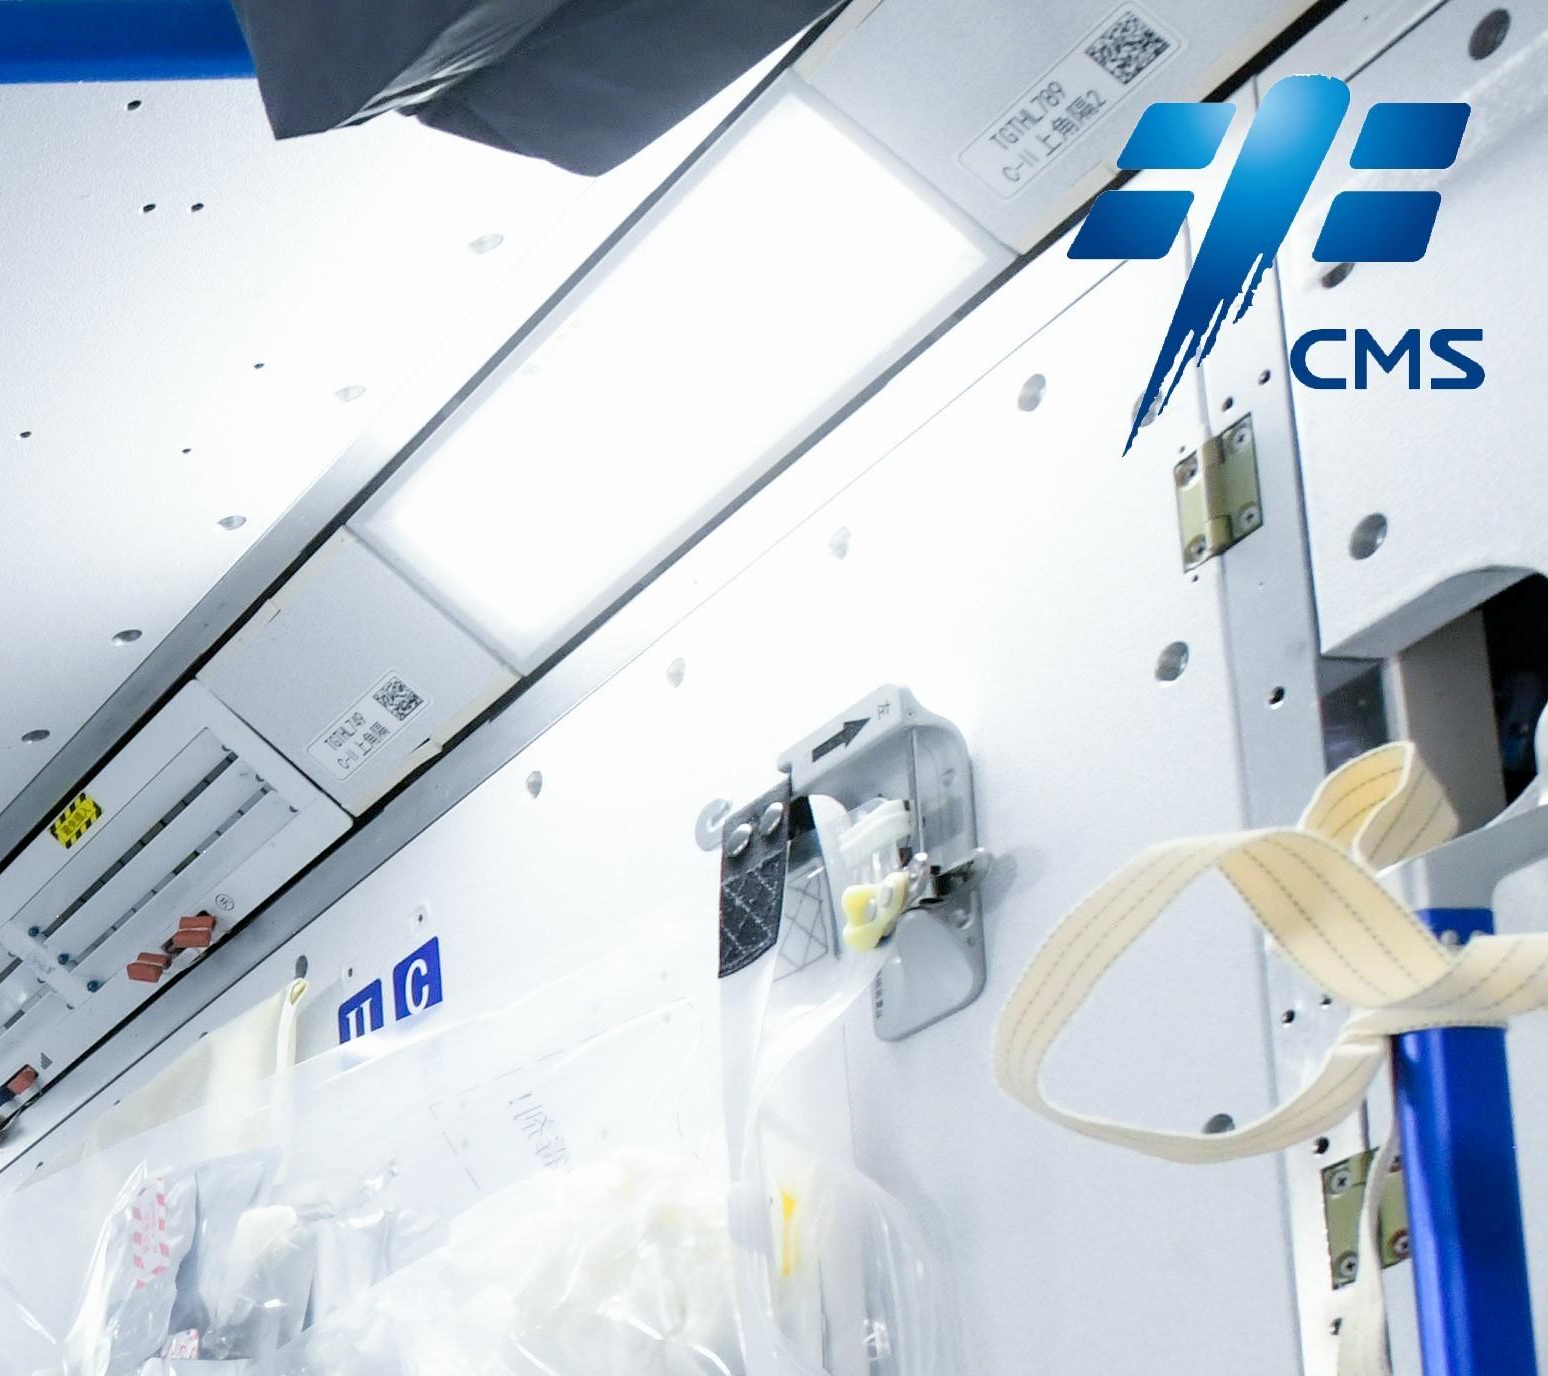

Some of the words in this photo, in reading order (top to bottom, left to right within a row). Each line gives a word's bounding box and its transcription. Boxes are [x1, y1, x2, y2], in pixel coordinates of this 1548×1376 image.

[989, 80, 1067, 152] TGTHL789
[324, 711, 366, 751] TGTHL749
[406, 957, 430, 1016] C
